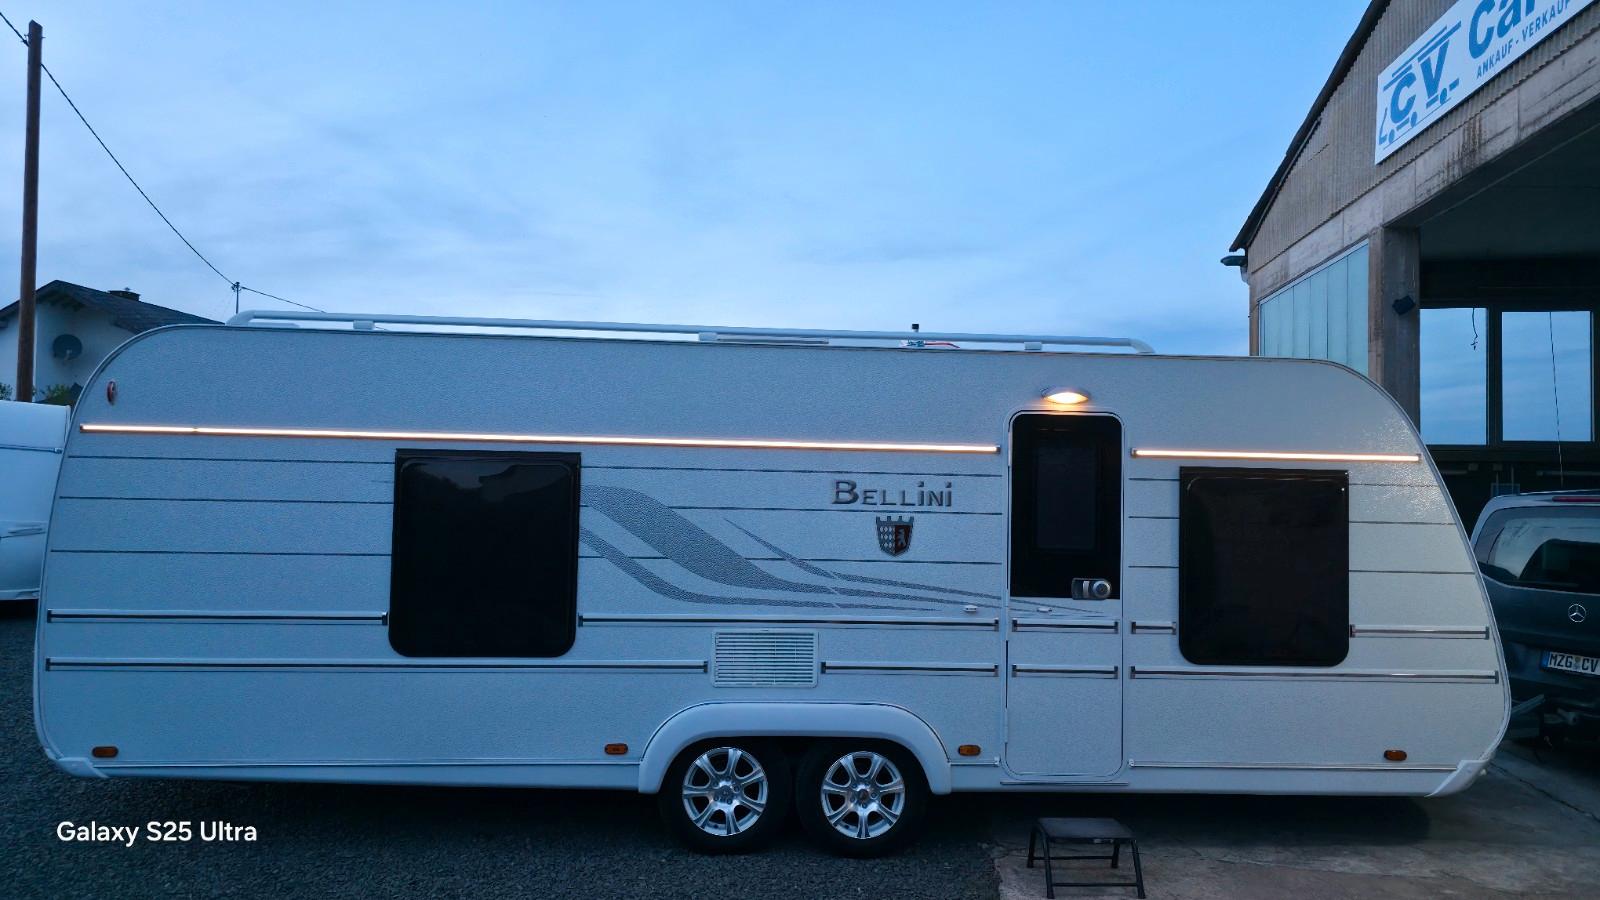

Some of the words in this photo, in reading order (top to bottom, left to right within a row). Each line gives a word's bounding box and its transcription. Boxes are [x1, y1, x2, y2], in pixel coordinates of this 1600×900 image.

[1469, 0, 1536, 59] Ca
[1390, 39, 1450, 124] CV
[1476, 38, 1514, 79] ANKAUF
[1549, 654, 1574, 669] MZG
